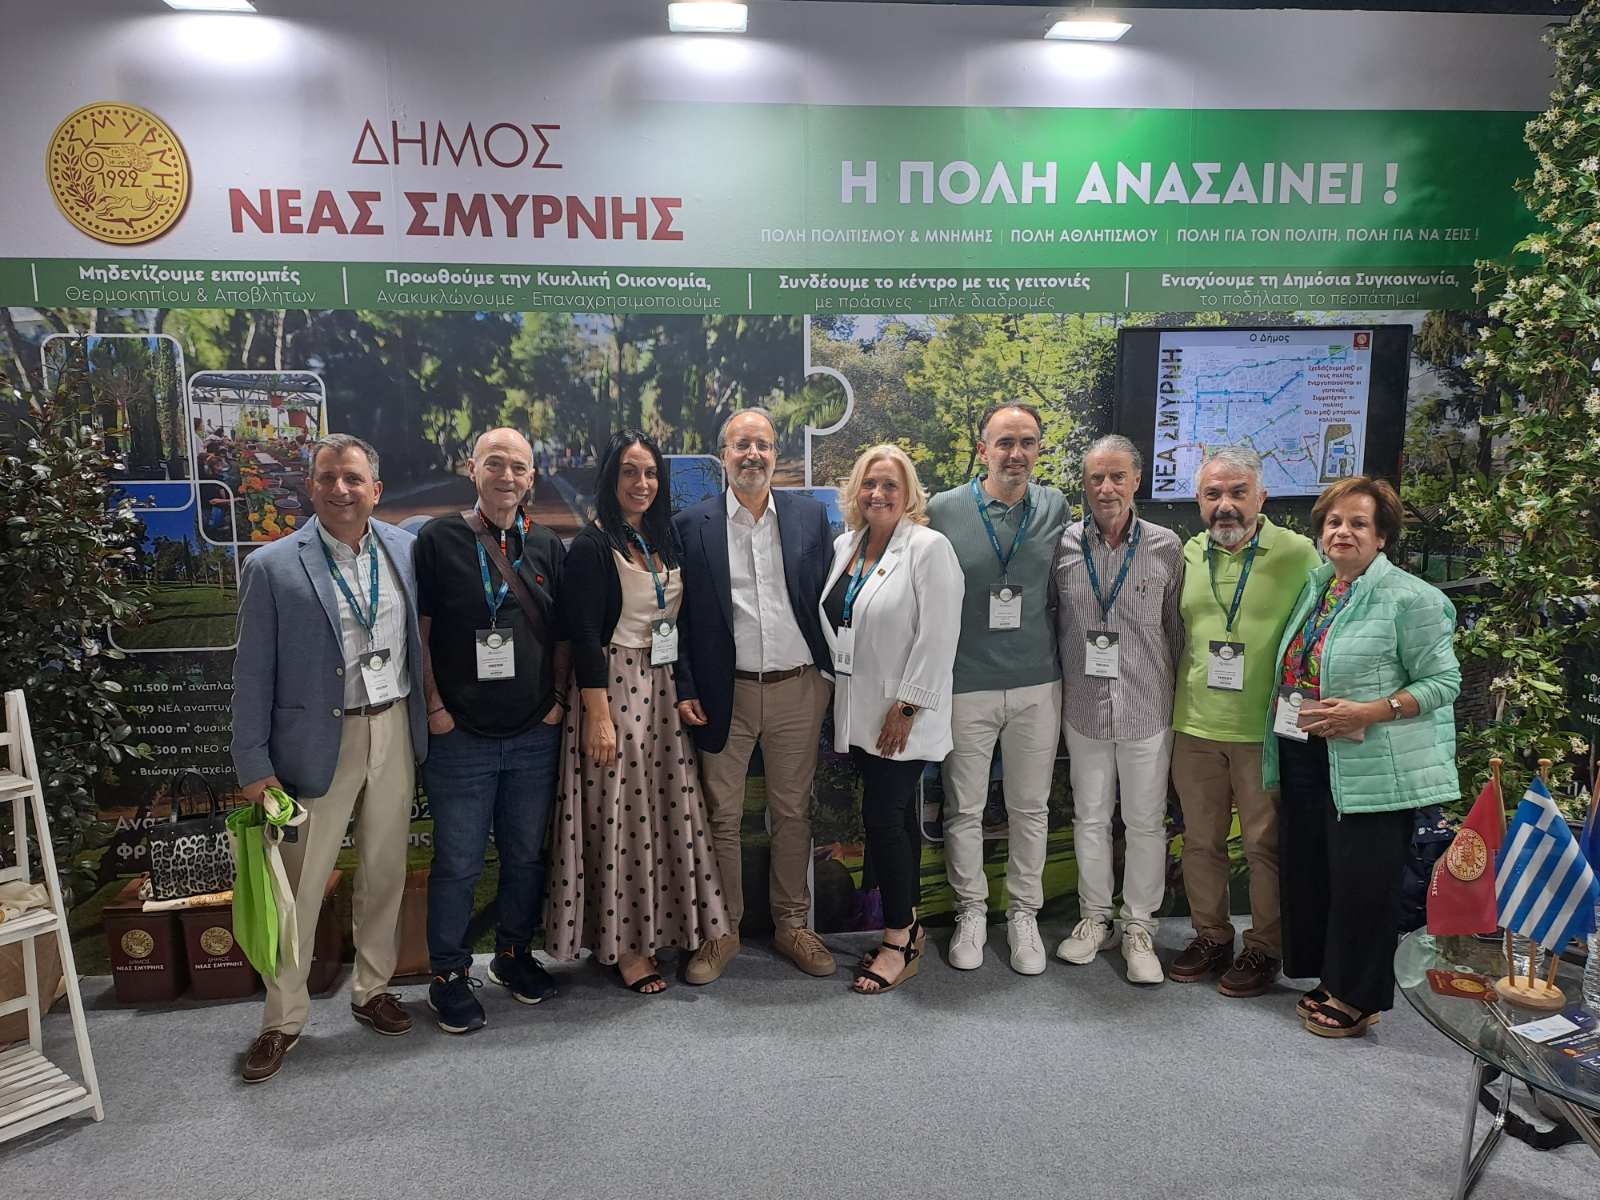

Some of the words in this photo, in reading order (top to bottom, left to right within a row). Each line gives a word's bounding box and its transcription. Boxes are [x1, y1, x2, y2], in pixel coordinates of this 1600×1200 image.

[67, 114, 175, 190] ΣΜΥΡΝΗ
[351, 118, 563, 169] ΔΗΜΟΣ
[98, 170, 143, 189] 1922
[841, 161, 878, 204] Η
[899, 160, 1059, 204] ΠΟΛΗ
[1075, 161, 1363, 205] ΑΝΑΣΑΙΝΕΙ
[228, 188, 385, 235] ΝΕΑΣ
[403, 191, 685, 241] ΣΜΥΡΝΗΣ
[761, 229, 806, 243] ΠΟΛΗ
[811, 229, 905, 243] ΠΟΛΙΤΙΣΜΟΥ
[910, 229, 920, 243] &
[925, 229, 993, 243] ΜΝΗΜΗΣ
[1011, 229, 1055, 242] ΠΟΛΗ
[1060, 229, 1158, 242] ΑΘΛΗΤΙΣΜΟΥ
[1177, 228, 1220, 242] ΠΟΛΗ
[1224, 228, 1246, 242] ΓΙΑ
[1251, 228, 1280, 242] ΤΟΝ
[1285, 228, 1341, 243] ΠΟΛΙΤΗ,
[1346, 228, 1388, 242] ΠΟΛΗ
[1393, 228, 1414, 242] ΓΙΑ
[1419, 228, 1440, 242] ΝΑ
[1444, 228, 1472, 242] ΖΕΙΣ
[79, 265, 205, 284] Μηδενίζουμε
[211, 268, 300, 285] εκπομπές
[385, 269, 495, 286] Προωθούμε
[500, 274, 531, 288] την
[537, 272, 611, 290] Κυκλική
[616, 273, 711, 291] Οικονομία,
[779, 274, 869, 291] Συνδέουμε
[875, 278, 894, 289] το
[900, 275, 957, 291] κέντρο
[962, 278, 982, 290] με
[986, 278, 1009, 291] τις
[1014, 275, 1091, 291] γειτονιές
[1162, 272, 1254, 289] Ενισχύουμε
[1259, 275, 1278, 288] τη
[1283, 272, 1351, 289] Δημόσια
[1356, 272, 1460, 288] Συγκοινωνία,
[65, 286, 190, 305] Θερμοκηπίου
[197, 288, 208, 302] &
[214, 286, 316, 306] Αποβλήτων
[376, 289, 514, 307] Ανακυκλώνουμε
[532, 291, 721, 311] Επαναχρησιμοποιούμε
[815, 296, 833, 310] με
[839, 294, 912, 310] πράσινες
[928, 295, 965, 310] μπλε
[971, 293, 1055, 310] διαδρομές
[1200, 294, 1217, 305] το
[1223, 290, 1302, 307] ποδήλατο,
[1308, 293, 1325, 305] το
[1330, 290, 1420, 307] περπάτημα!
[1249, 333, 1258, 342] Ο
[1260, 333, 1290, 343] Δήμος
[1158, 348, 1184, 441] ΣΜΥΡΝΗ
[1155, 446, 1177, 493] ΝΕΑ
[132, 683, 169, 693] 11.500
[158, 704, 181, 713] ΝΕΑ
[137, 725, 173, 734] 11.000
[195, 744, 218, 753] ΝΕΟ
